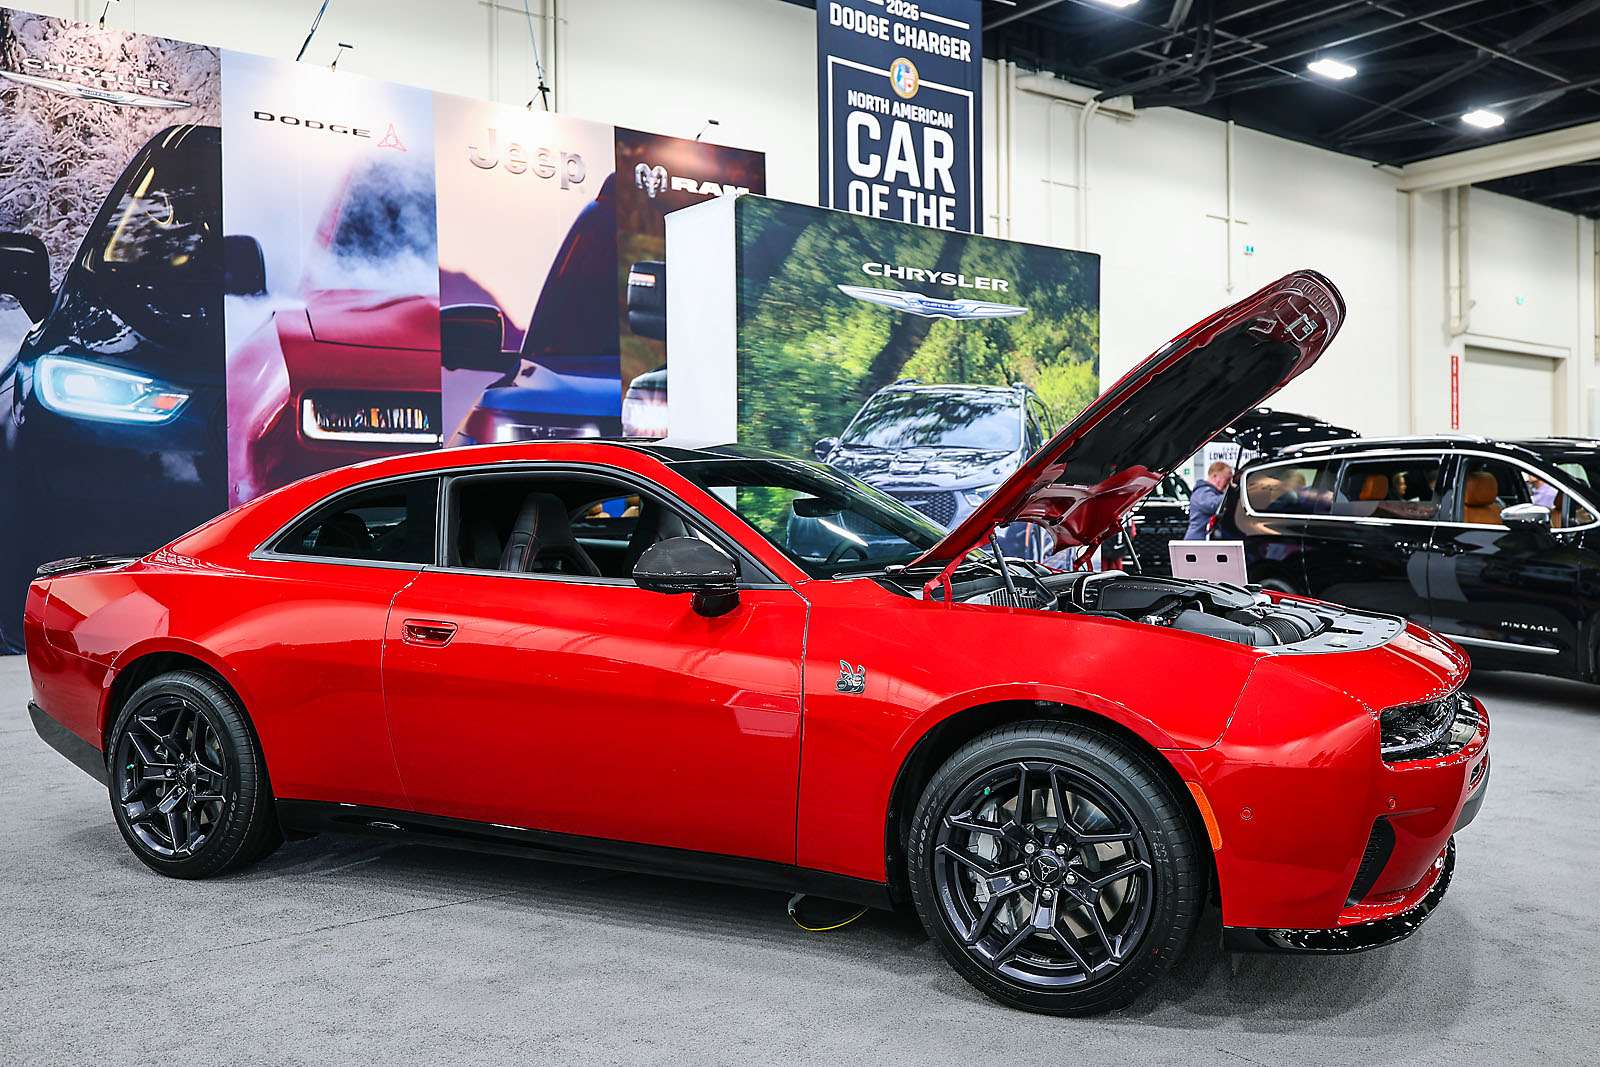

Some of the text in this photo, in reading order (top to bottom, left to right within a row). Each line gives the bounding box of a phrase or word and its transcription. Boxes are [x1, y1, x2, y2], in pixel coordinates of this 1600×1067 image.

[886, 0, 920, 21] 2026
[829, 2, 972, 62] DODGE CHARGER
[22, 58, 171, 92] CHRYSLER
[254, 111, 371, 138] DODGE
[847, 89, 954, 129] NORTH AMERICAN
[468, 128, 586, 190] Jeep
[846, 110, 956, 194] CAR
[848, 180, 956, 231] OF THE
[862, 262, 1009, 292] CHRYSLER
[922, 301, 961, 310] CHRYSLER
